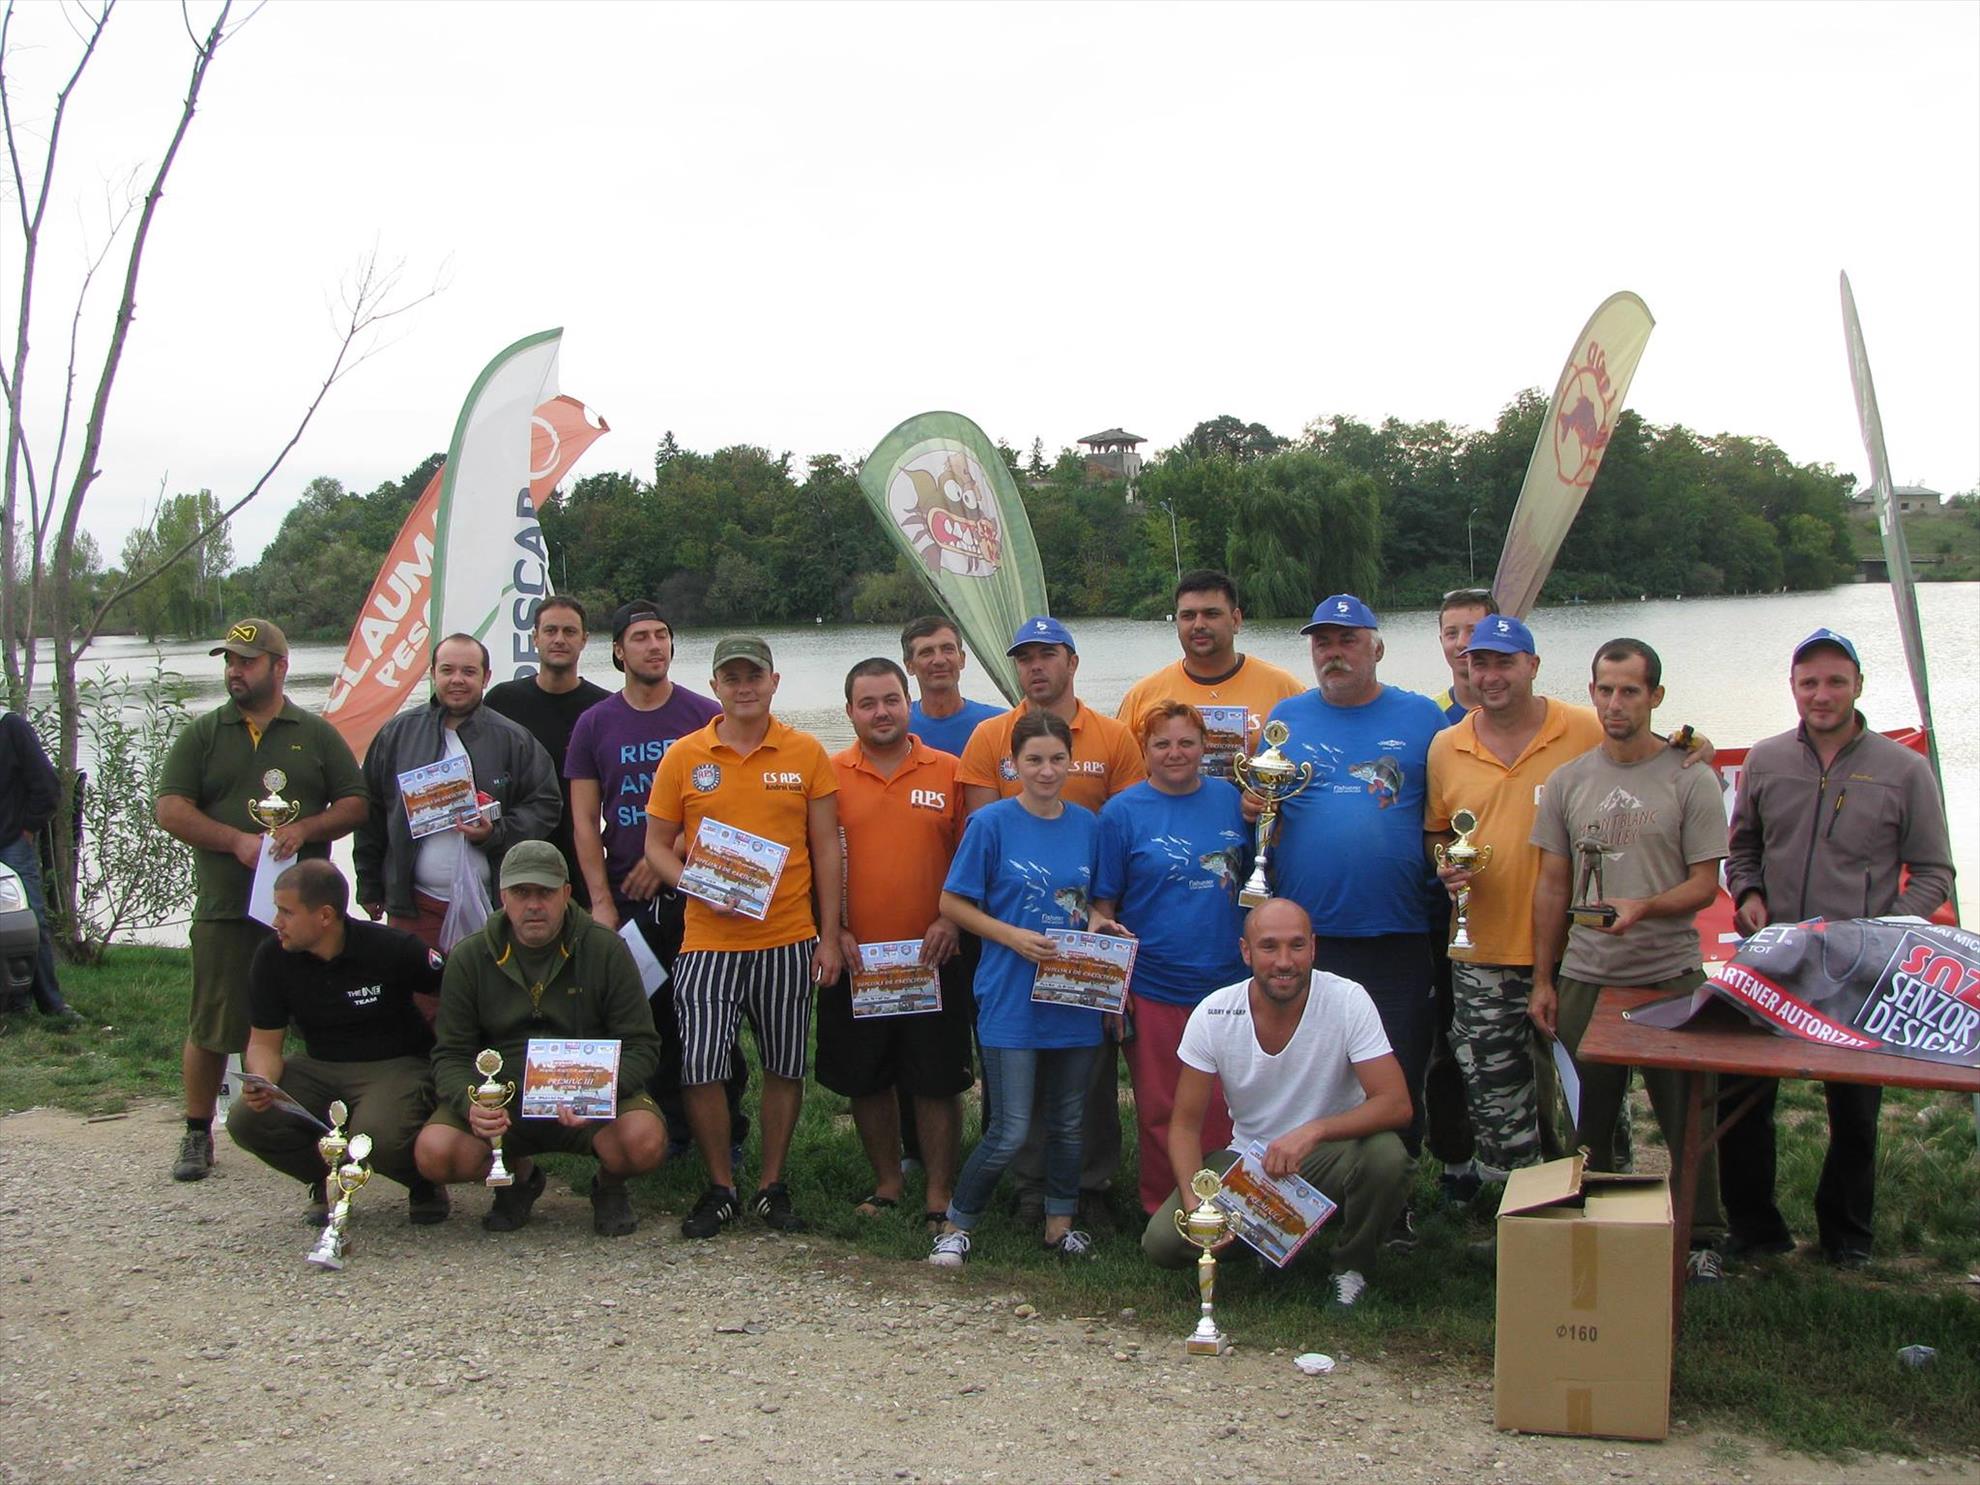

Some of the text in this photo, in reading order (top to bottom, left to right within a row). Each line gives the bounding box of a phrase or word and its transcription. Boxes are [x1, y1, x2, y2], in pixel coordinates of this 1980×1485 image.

[375, 597, 431, 688] PES
[620, 772, 655, 796] AN
[780, 772, 802, 784] APS
[911, 789, 945, 809] APS
[618, 805, 648, 826] SH
[1953, 934, 1980, 953] MIC
[1711, 966, 1869, 1049] ARTENER AUTORIZAT
[1883, 972, 1980, 1045] SENZOR
[1864, 1000, 1967, 1055] DESIGN
